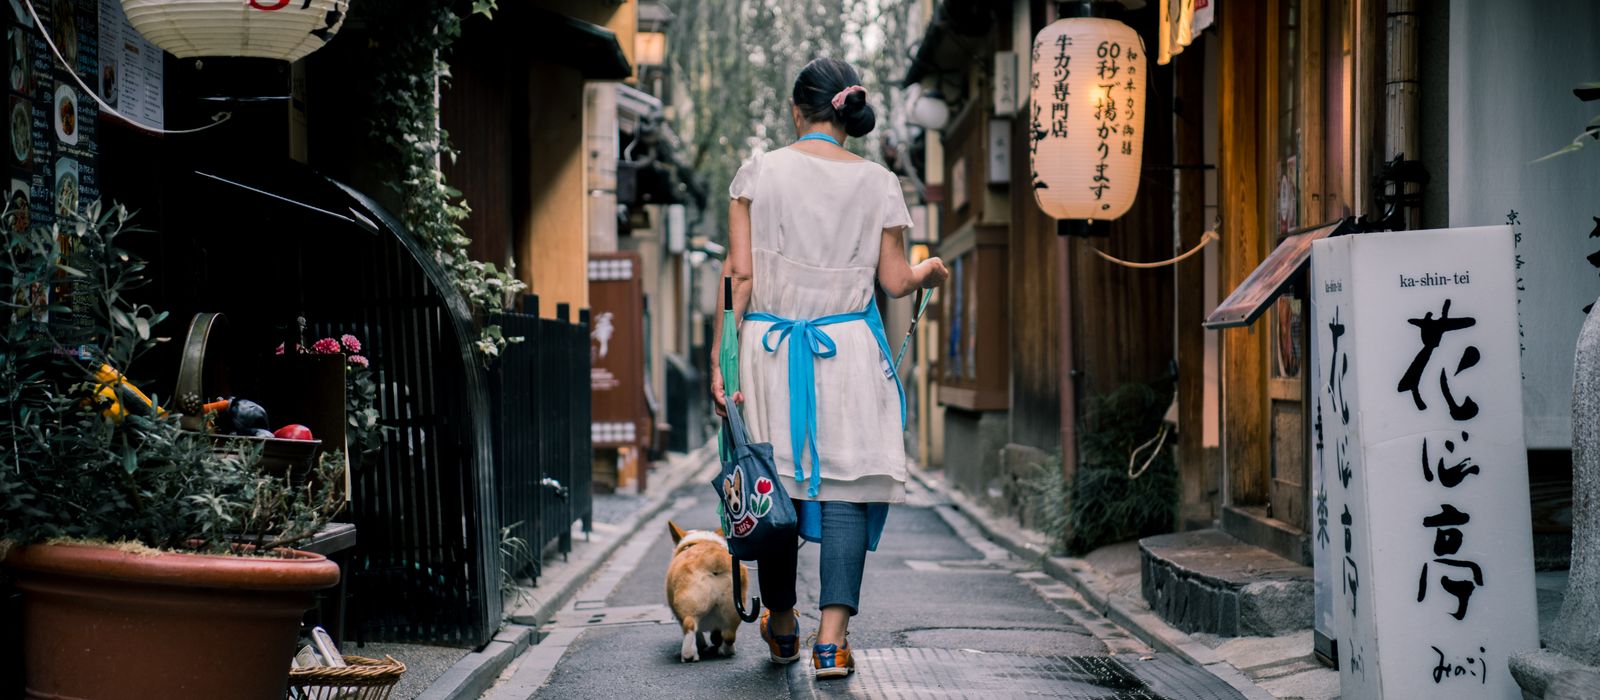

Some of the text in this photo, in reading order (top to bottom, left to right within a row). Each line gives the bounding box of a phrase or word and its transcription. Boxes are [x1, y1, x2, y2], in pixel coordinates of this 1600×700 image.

[1051, 34, 1073, 138] 牛カツ専門店
[1089, 40, 1121, 210] 60秒で揚がります。
[1399, 270, 1471, 287] ka-shin-tei
